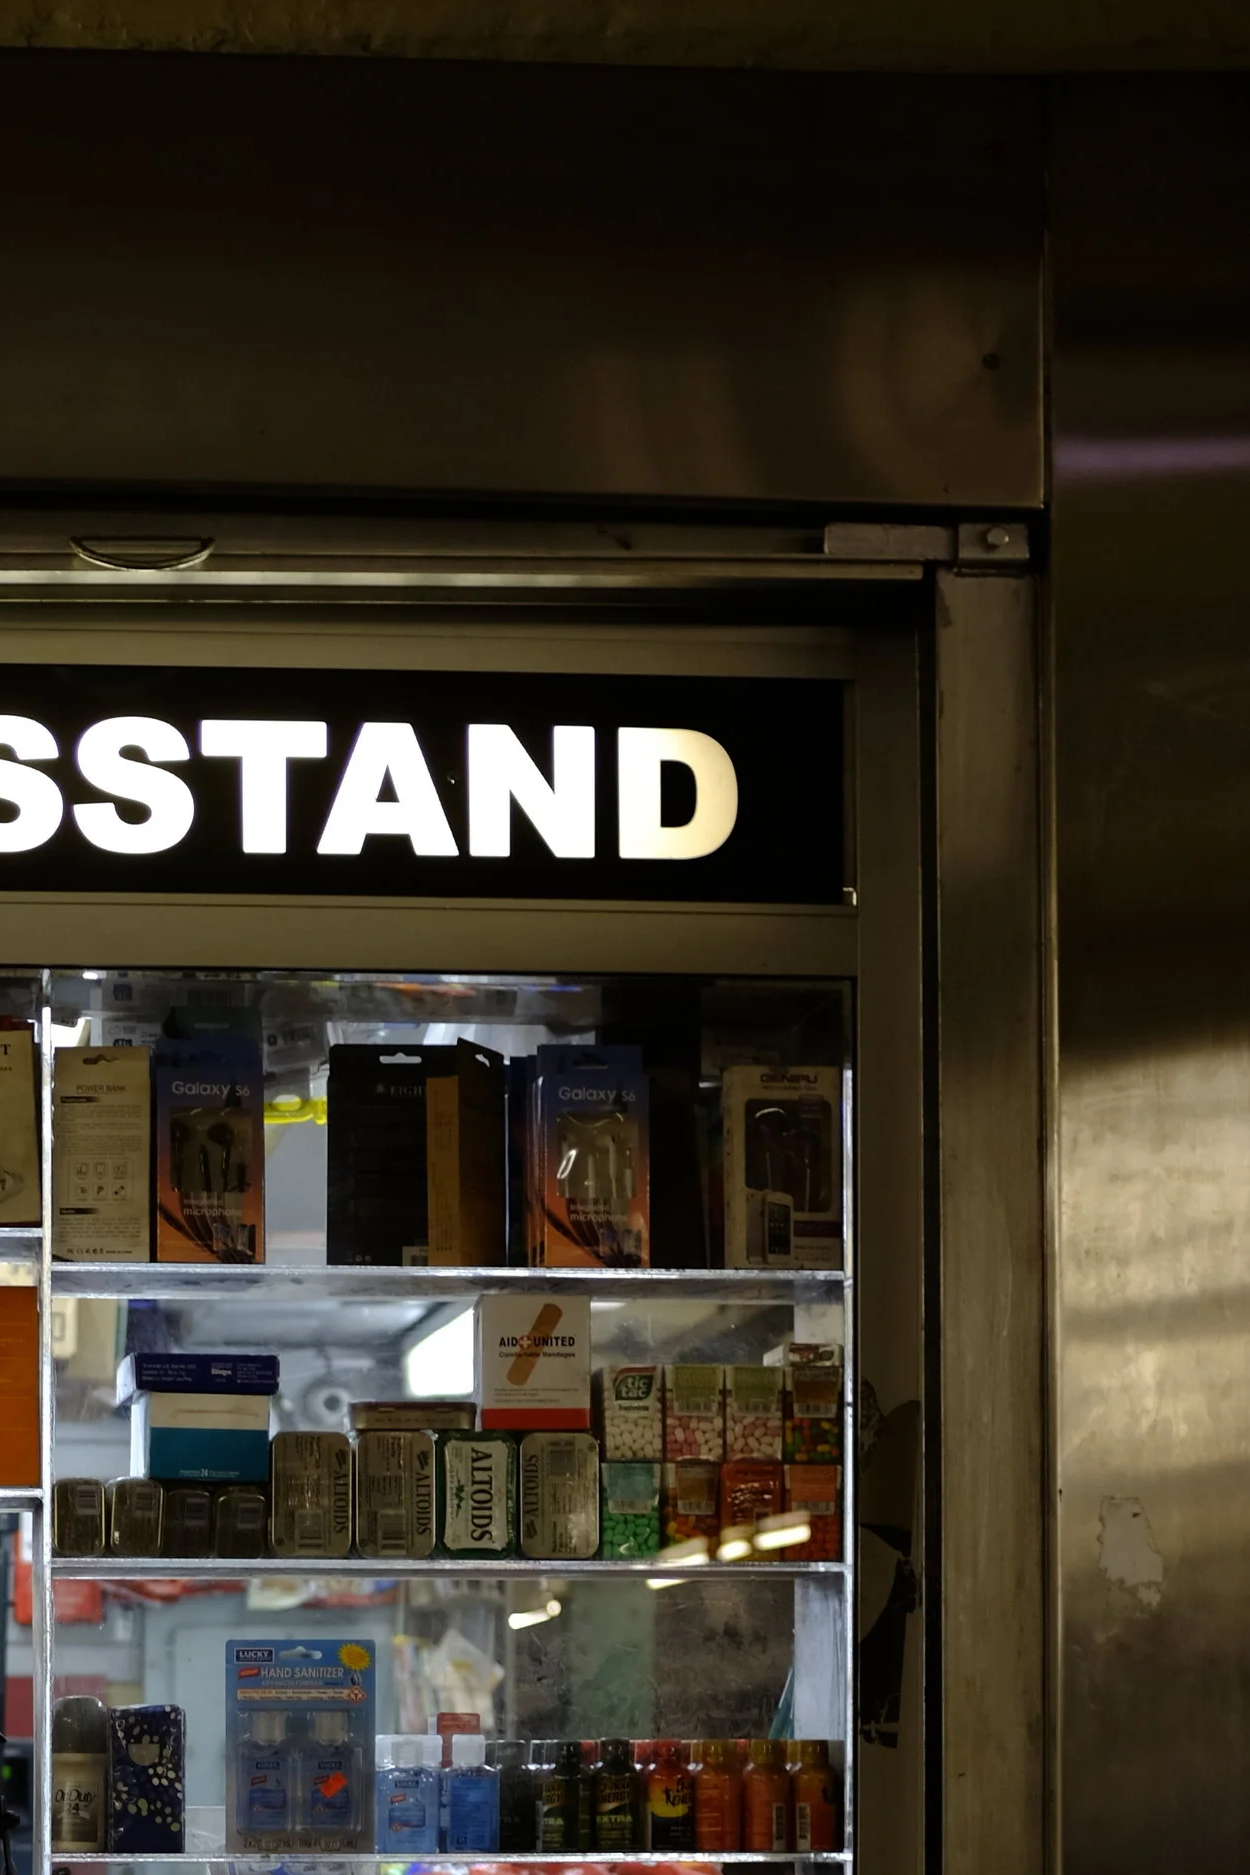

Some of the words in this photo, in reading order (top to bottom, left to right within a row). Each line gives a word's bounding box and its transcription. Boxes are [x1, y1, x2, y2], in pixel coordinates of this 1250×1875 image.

[172, 1081, 230, 1098] Galaxy
[235, 1086, 250, 1097] S6
[559, 1086, 616, 1104] Galaxy
[622, 1090, 636, 1102] S6
[533, 1336, 575, 1347] UNITED
[629, 1373, 649, 1387] tic
[622, 1386, 647, 1398] tac
[470, 1447, 493, 1541] ALTOIDS
[523, 1454, 539, 1518] ALTOIDS
[334, 1470, 349, 1533] ALTOIDS
[416, 1472, 432, 1535] ALTOIDS
[239, 1650, 269, 1659] LUCKY
[261, 1667, 291, 1678] HAND
[293, 1667, 344, 1678] SANITIZER
